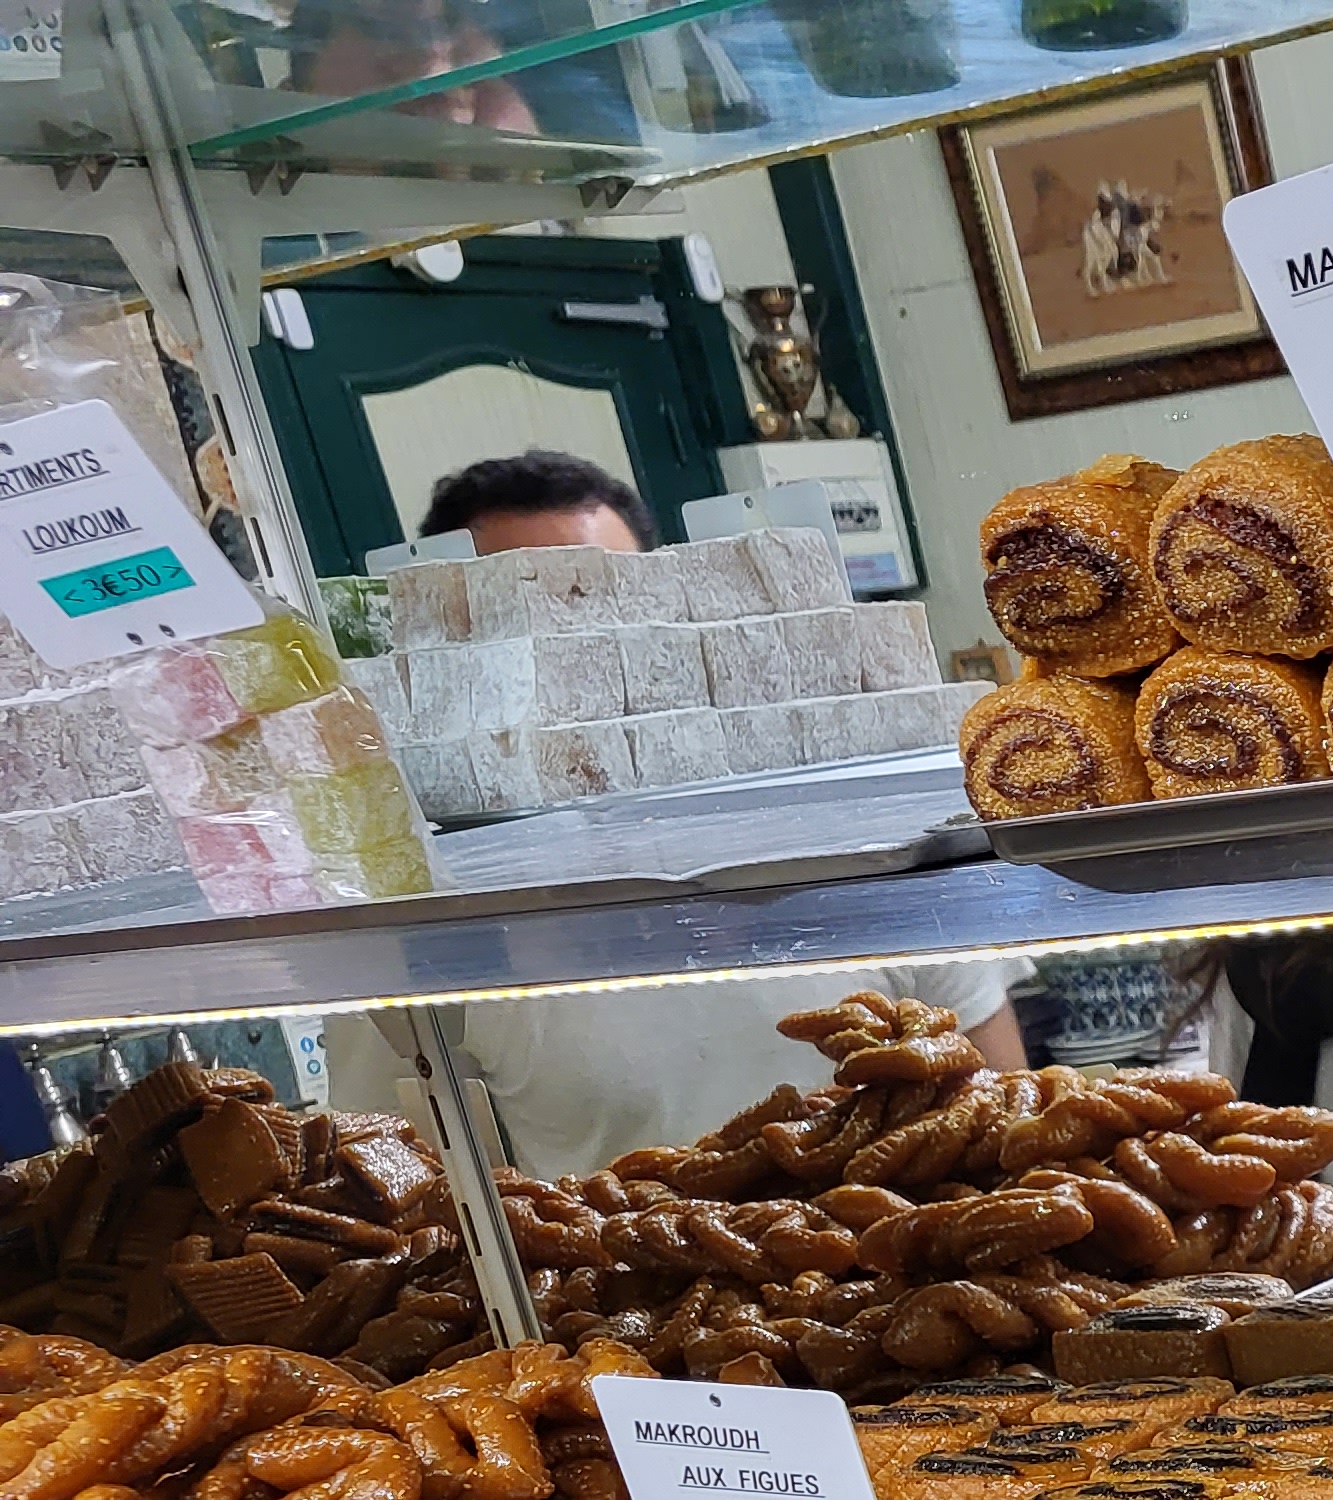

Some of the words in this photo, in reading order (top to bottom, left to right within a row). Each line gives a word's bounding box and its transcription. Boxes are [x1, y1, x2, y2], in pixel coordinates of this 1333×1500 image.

[23, 507, 132, 551] LOUKOUM
[634, 1420, 760, 1450] MAKROUDH
[683, 1466, 727, 1487] AUX
[739, 1470, 819, 1495] FIGUES
